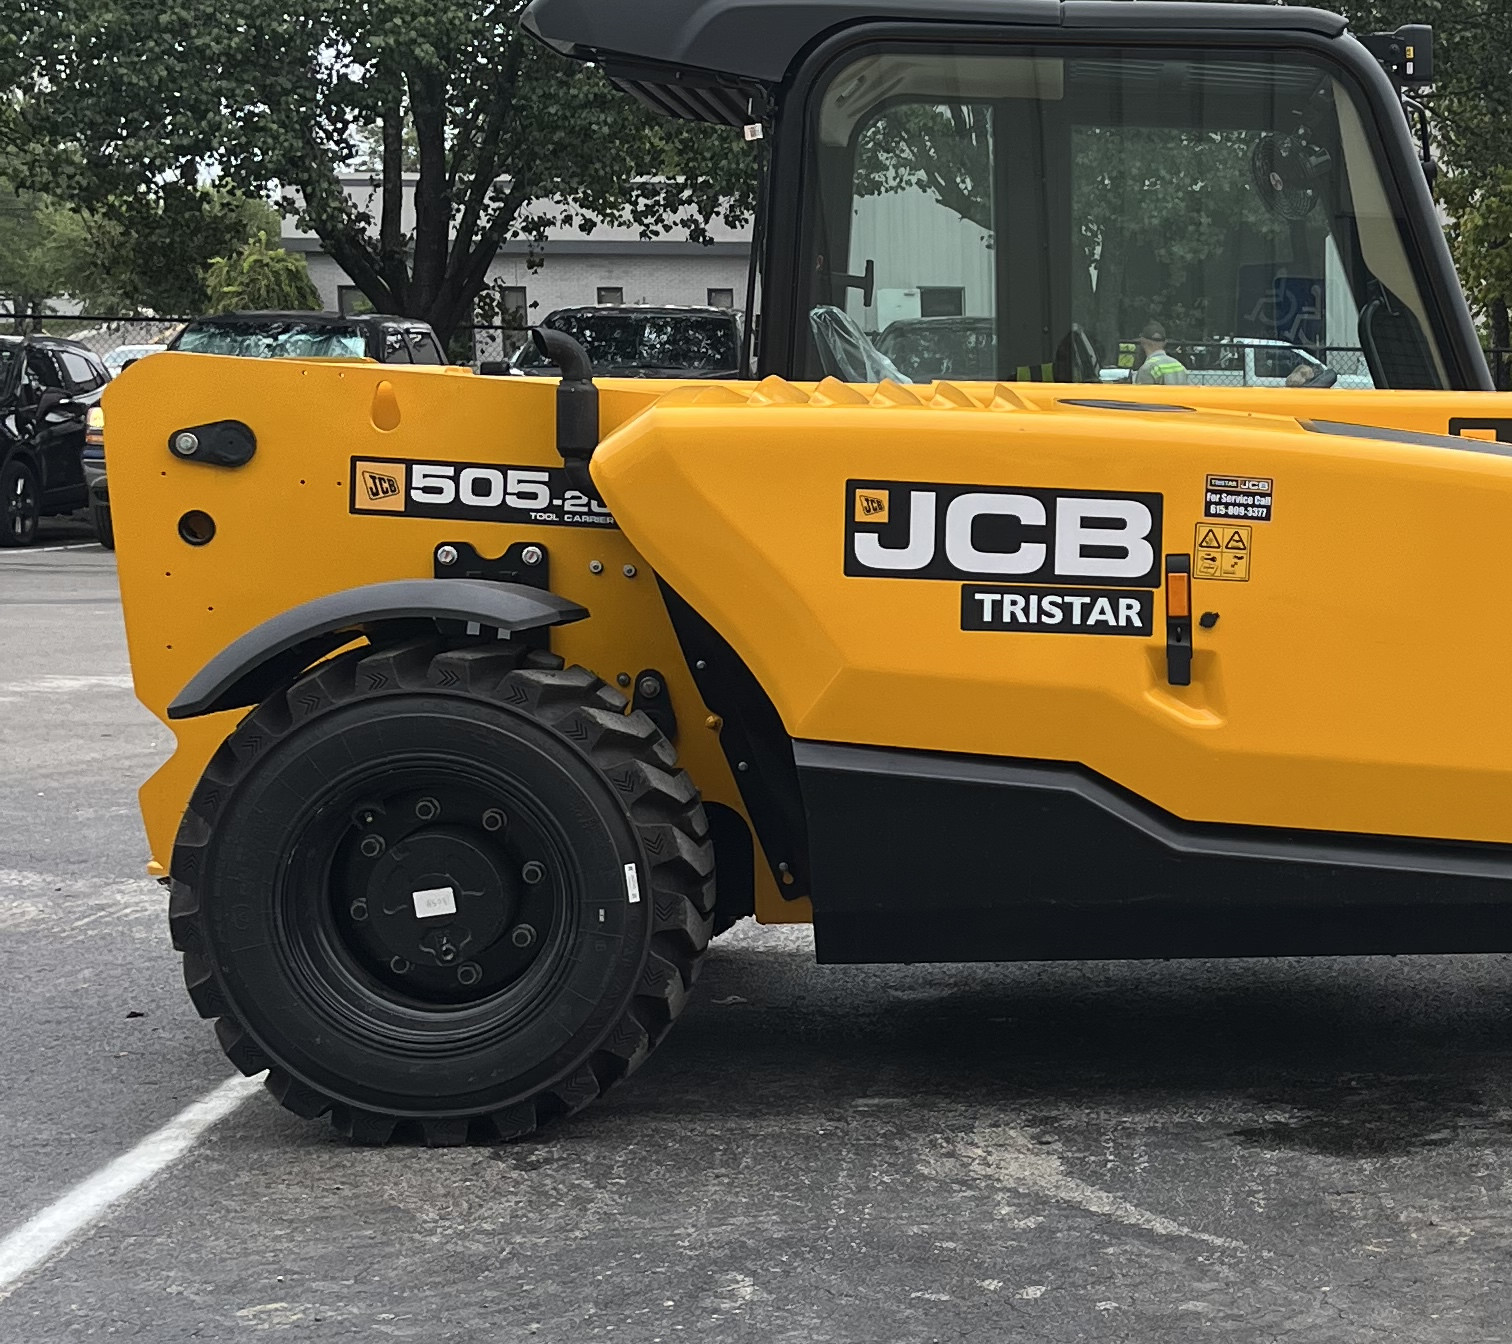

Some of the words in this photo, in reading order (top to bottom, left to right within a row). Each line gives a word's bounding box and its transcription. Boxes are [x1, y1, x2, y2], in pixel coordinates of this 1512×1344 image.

[369, 475, 398, 497] JCB
[1240, 480, 1269, 490] JCB
[863, 497, 884, 514] JCB
[1221, 493, 1253, 504] Service
[1254, 496, 1272, 506] Call
[529, 512, 559, 521] TOOL
[564, 514, 614, 524] CARRIER
[854, 491, 1154, 578] JCB
[974, 593, 1143, 627] TRISTAR
